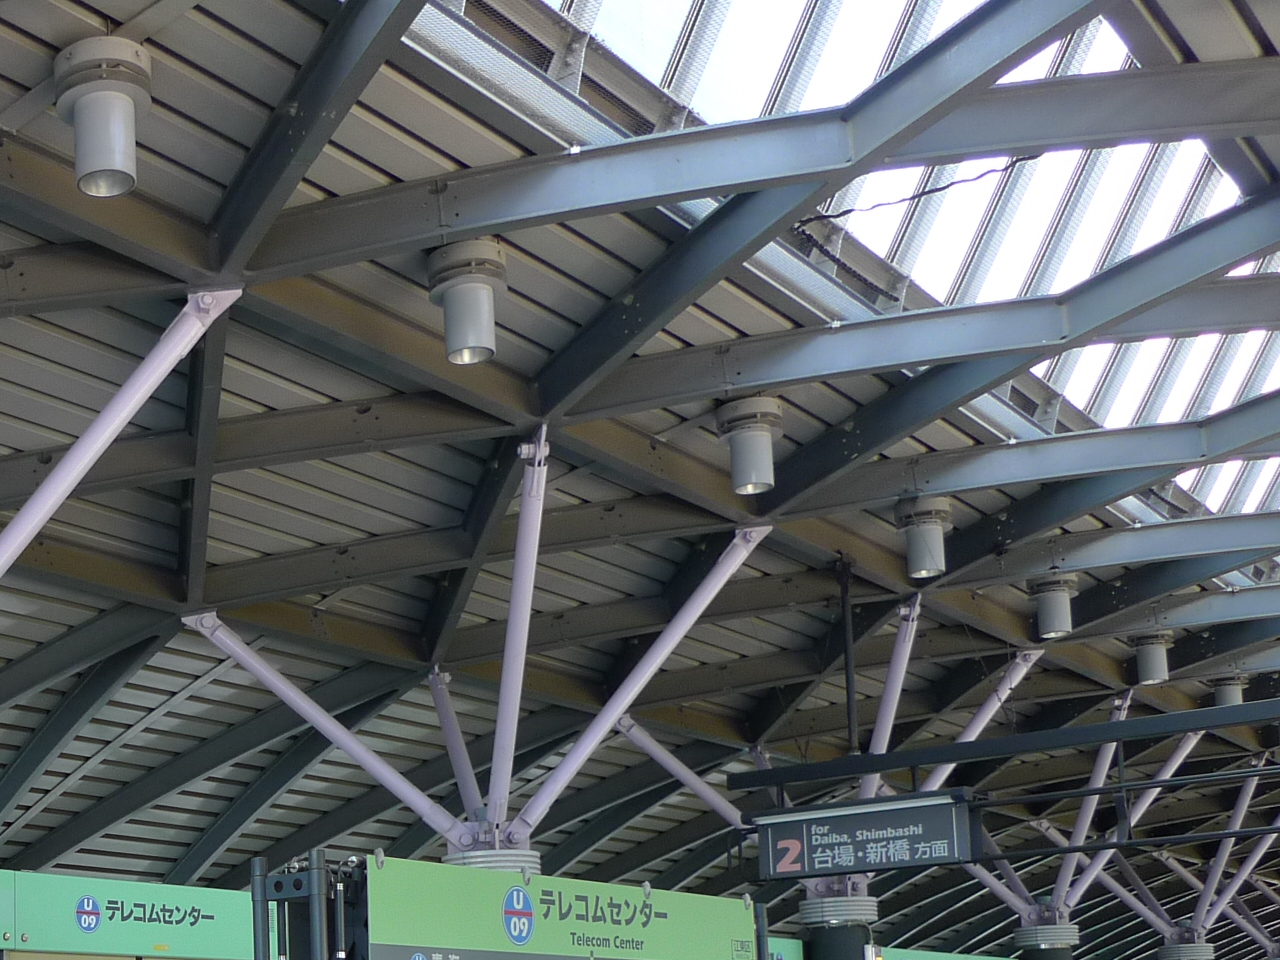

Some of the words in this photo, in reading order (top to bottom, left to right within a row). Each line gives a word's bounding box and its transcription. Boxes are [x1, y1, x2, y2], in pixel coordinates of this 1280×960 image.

[811, 824, 830, 835] for
[811, 832, 852, 846] Daiba,
[855, 824, 923, 841] Shimbashi
[776, 839, 802, 873] 2
[914, 839, 949, 860] 方面
[84, 899, 93, 911] U
[513, 890, 523, 909] U
[539, 889, 668, 929] テレコムセンター
[81, 915, 96, 928] 09
[105, 900, 215, 927] テレコムセンター
[510, 917, 529, 938] 09
[570, 932, 610, 950] Telecom
[614, 934, 645, 951] Center
